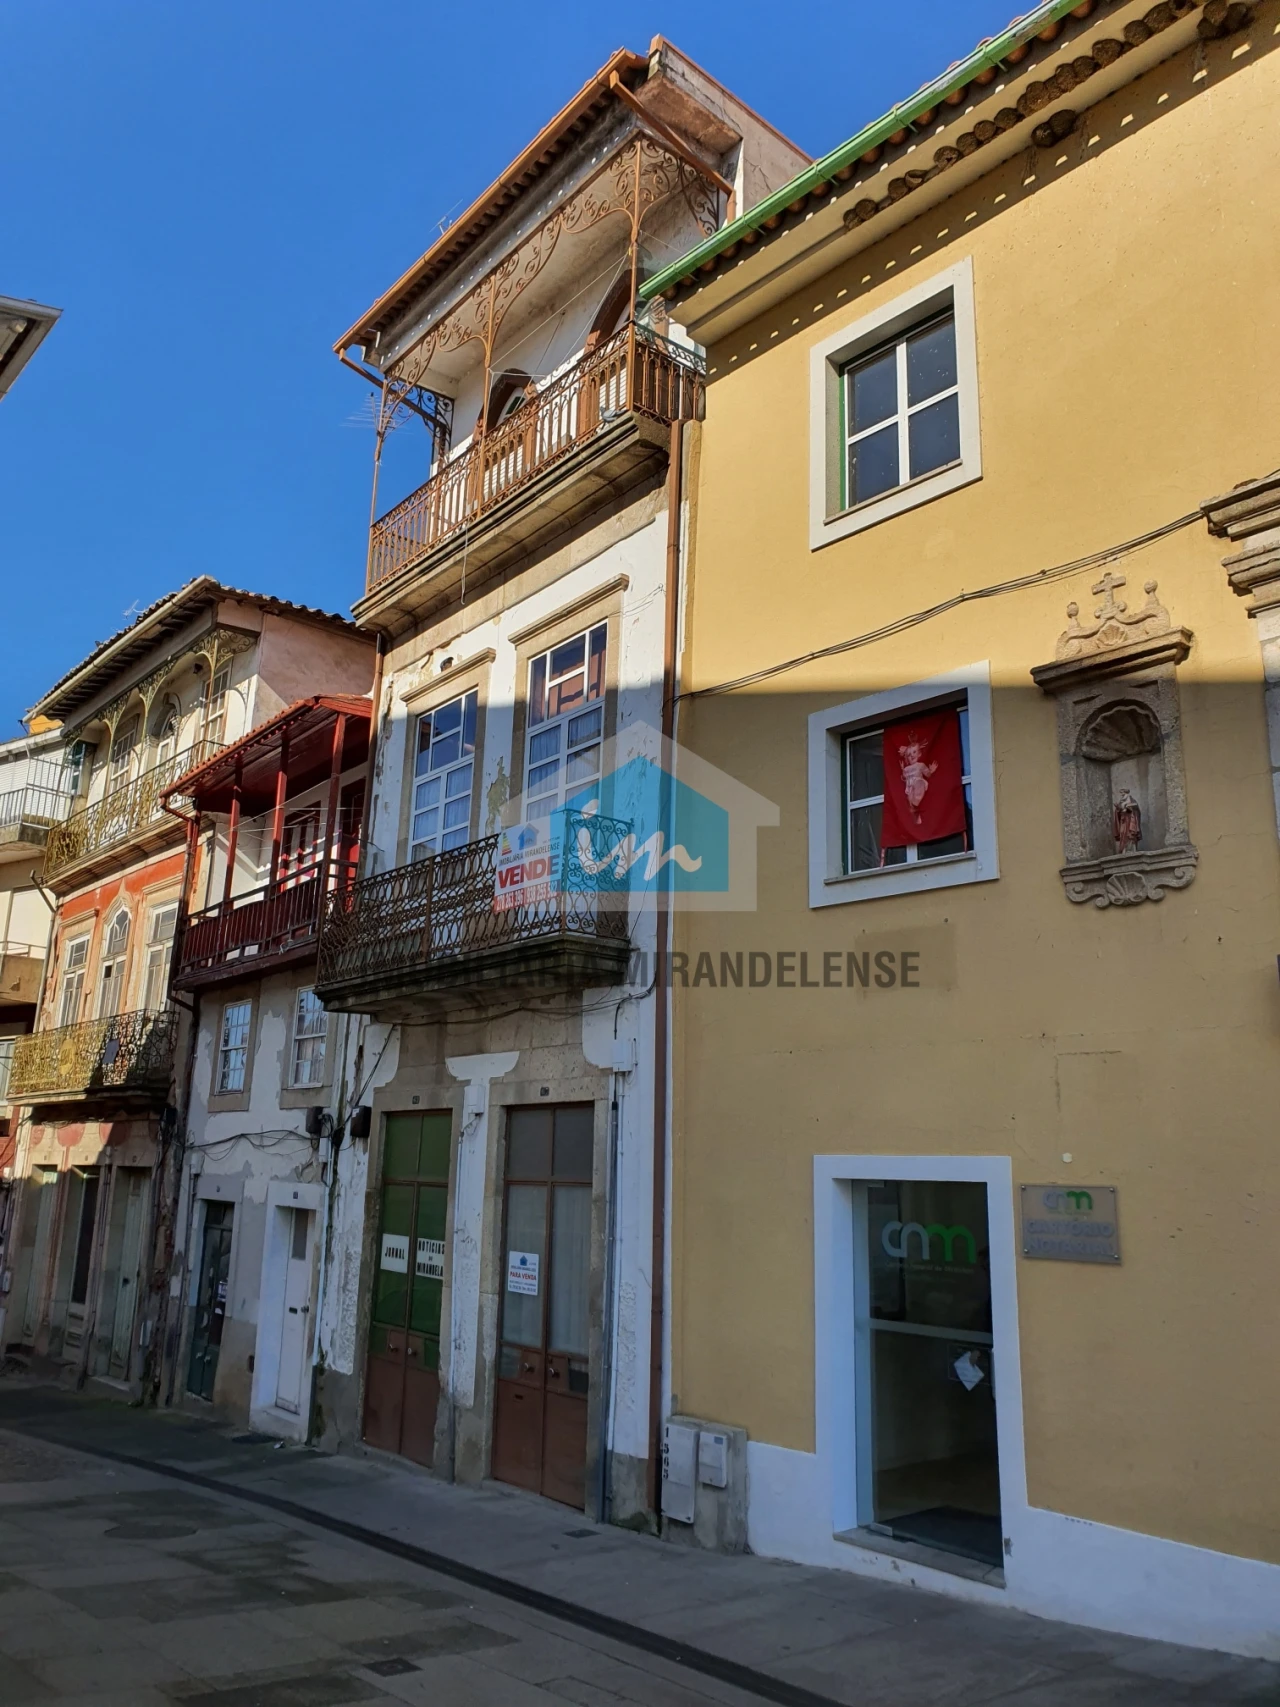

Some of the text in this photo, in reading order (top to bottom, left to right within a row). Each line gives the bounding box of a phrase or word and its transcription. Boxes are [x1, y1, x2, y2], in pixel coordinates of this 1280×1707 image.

[497, 854, 560, 888] VENDE
[881, 1221, 977, 1264] cnm
[385, 1246, 405, 1260] JORNAL
[417, 1262, 444, 1277] MIRANDELA
[510, 1271, 537, 1281] PARA VENDA
